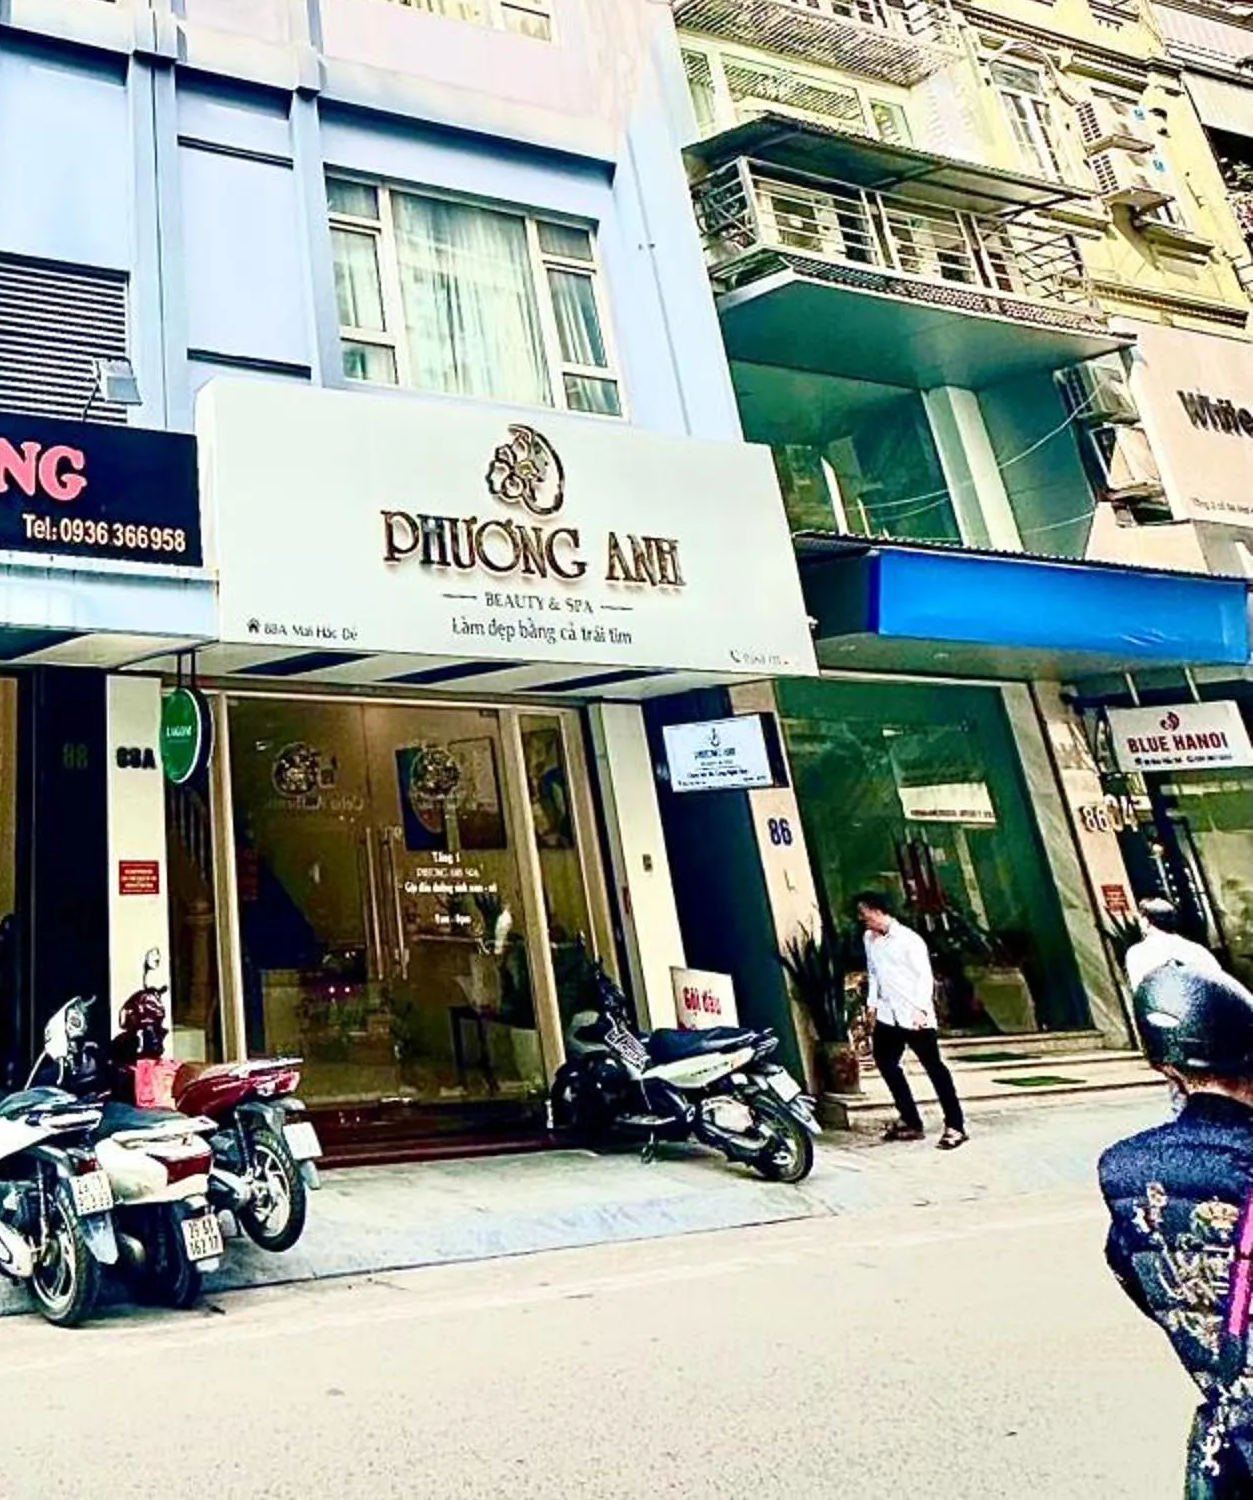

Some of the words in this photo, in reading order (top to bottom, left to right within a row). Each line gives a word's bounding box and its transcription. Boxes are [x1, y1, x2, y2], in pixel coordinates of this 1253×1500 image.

[380, 509, 589, 579] PHƯƠNG
[604, 531, 688, 587] ANH
[485, 591, 545, 610] BEAUTY
[548, 598, 561, 611] &
[565, 598, 594, 613] SPA
[1127, 736, 1170, 754] BLUE
[1173, 732, 1229, 750] HANOI
[767, 818, 793, 846] 86
